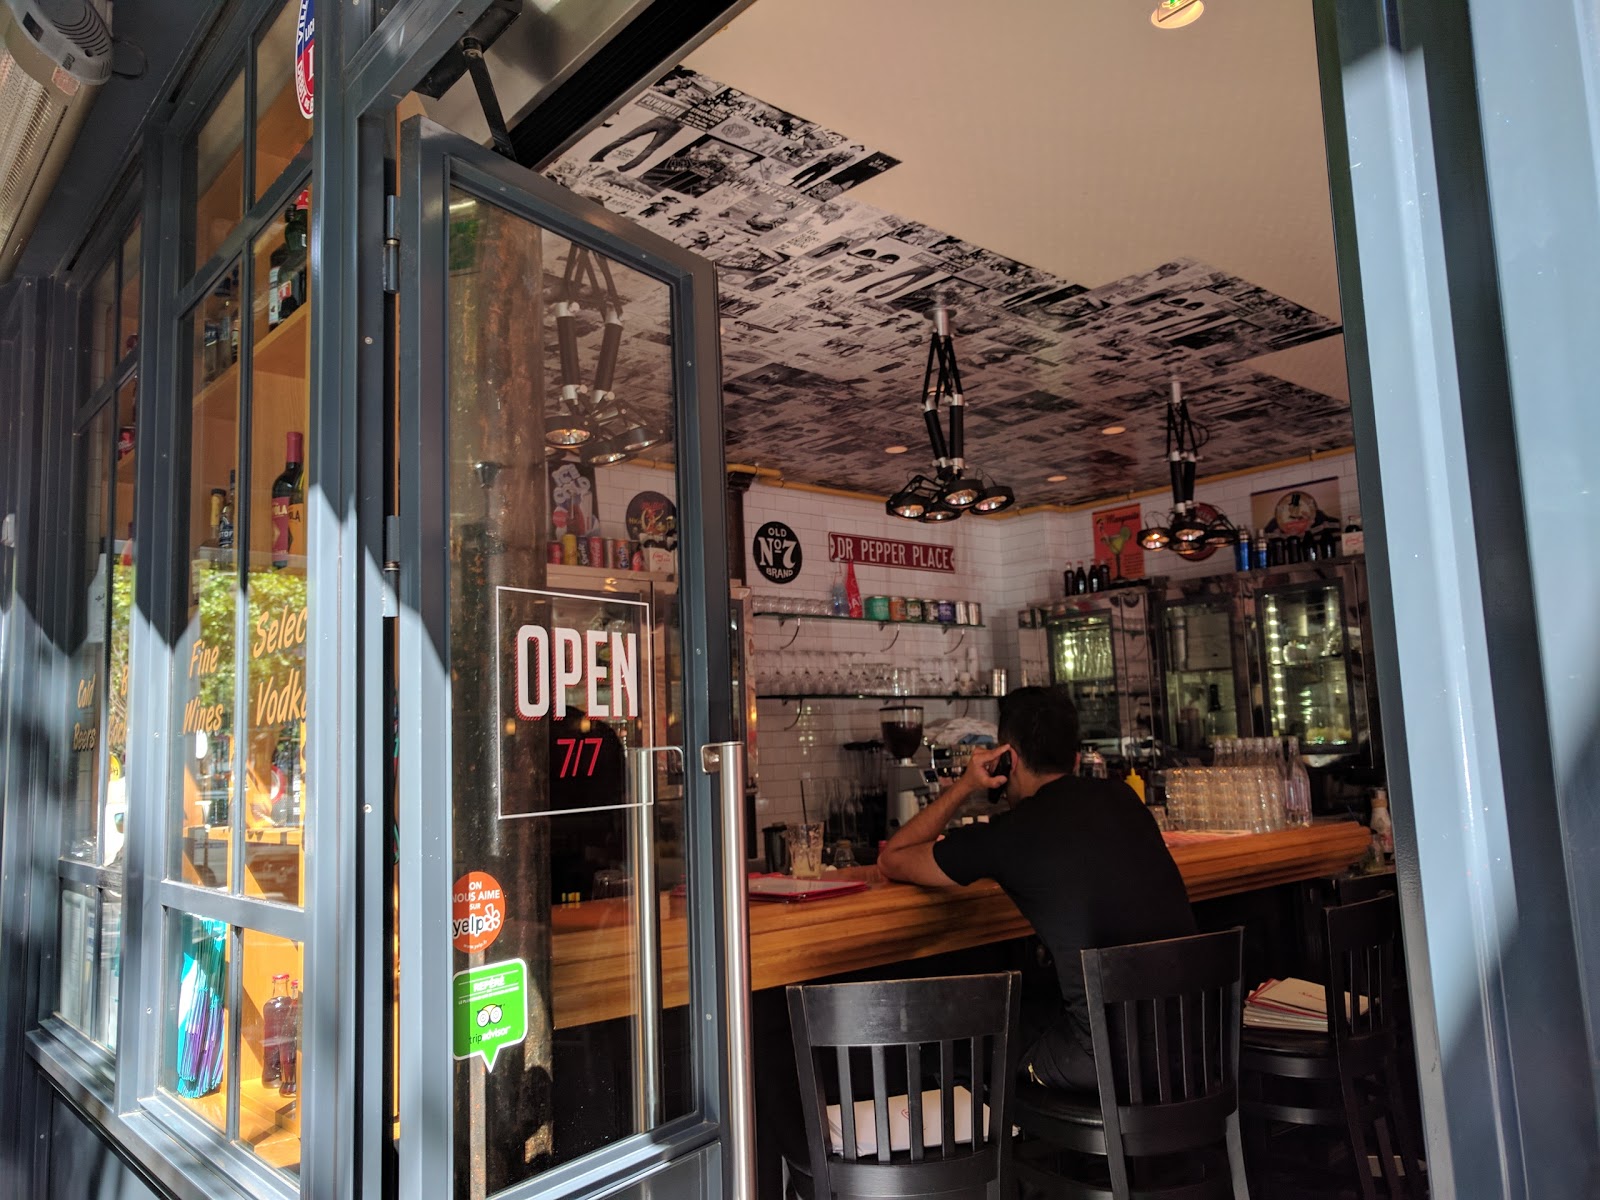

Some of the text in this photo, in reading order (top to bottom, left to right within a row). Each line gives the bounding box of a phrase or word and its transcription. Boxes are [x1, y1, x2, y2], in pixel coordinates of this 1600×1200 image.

[768, 527, 787, 537] OLD
[837, 537, 950, 569] DR PEPPER PLACE
[766, 567, 794, 579] BRAND
[189, 639, 219, 679] Fine
[514, 624, 638, 721] OPEN
[77, 673, 96, 708] Cold
[183, 696, 223, 735] Wines
[73, 722, 96, 750] Beers
[556, 737, 603, 778] 7/7
[469, 881, 482, 890] ON
[478, 889, 500, 900] AIME
[469, 902, 481, 910] SUR
[453, 915, 484, 937] yelp
